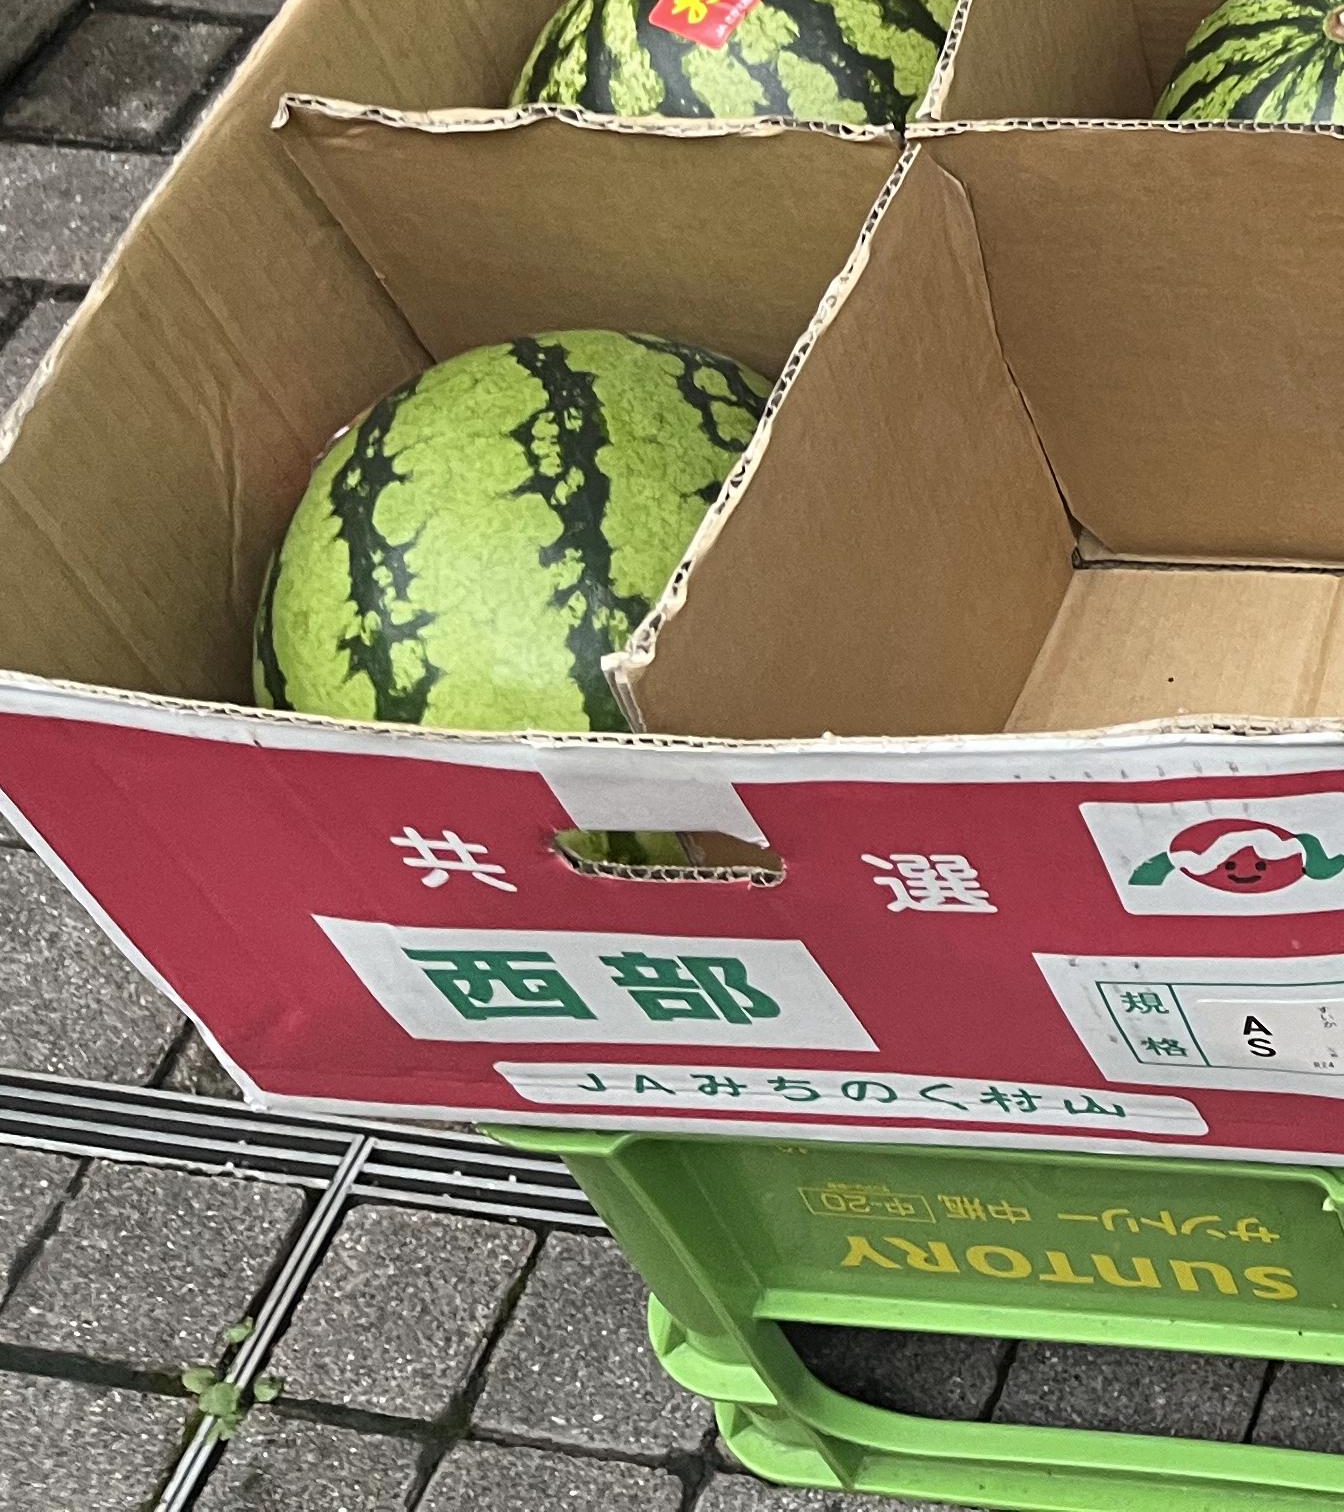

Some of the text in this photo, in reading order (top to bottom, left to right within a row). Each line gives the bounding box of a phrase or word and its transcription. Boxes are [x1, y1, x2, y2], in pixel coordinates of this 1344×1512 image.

[399, 947, 782, 1026] 西部
[577, 1071, 1127, 1121] JAみちのく村山
[1055, 1205, 1281, 1246] サントリー
[838, 1232, 1300, 1304] SUNTORY
